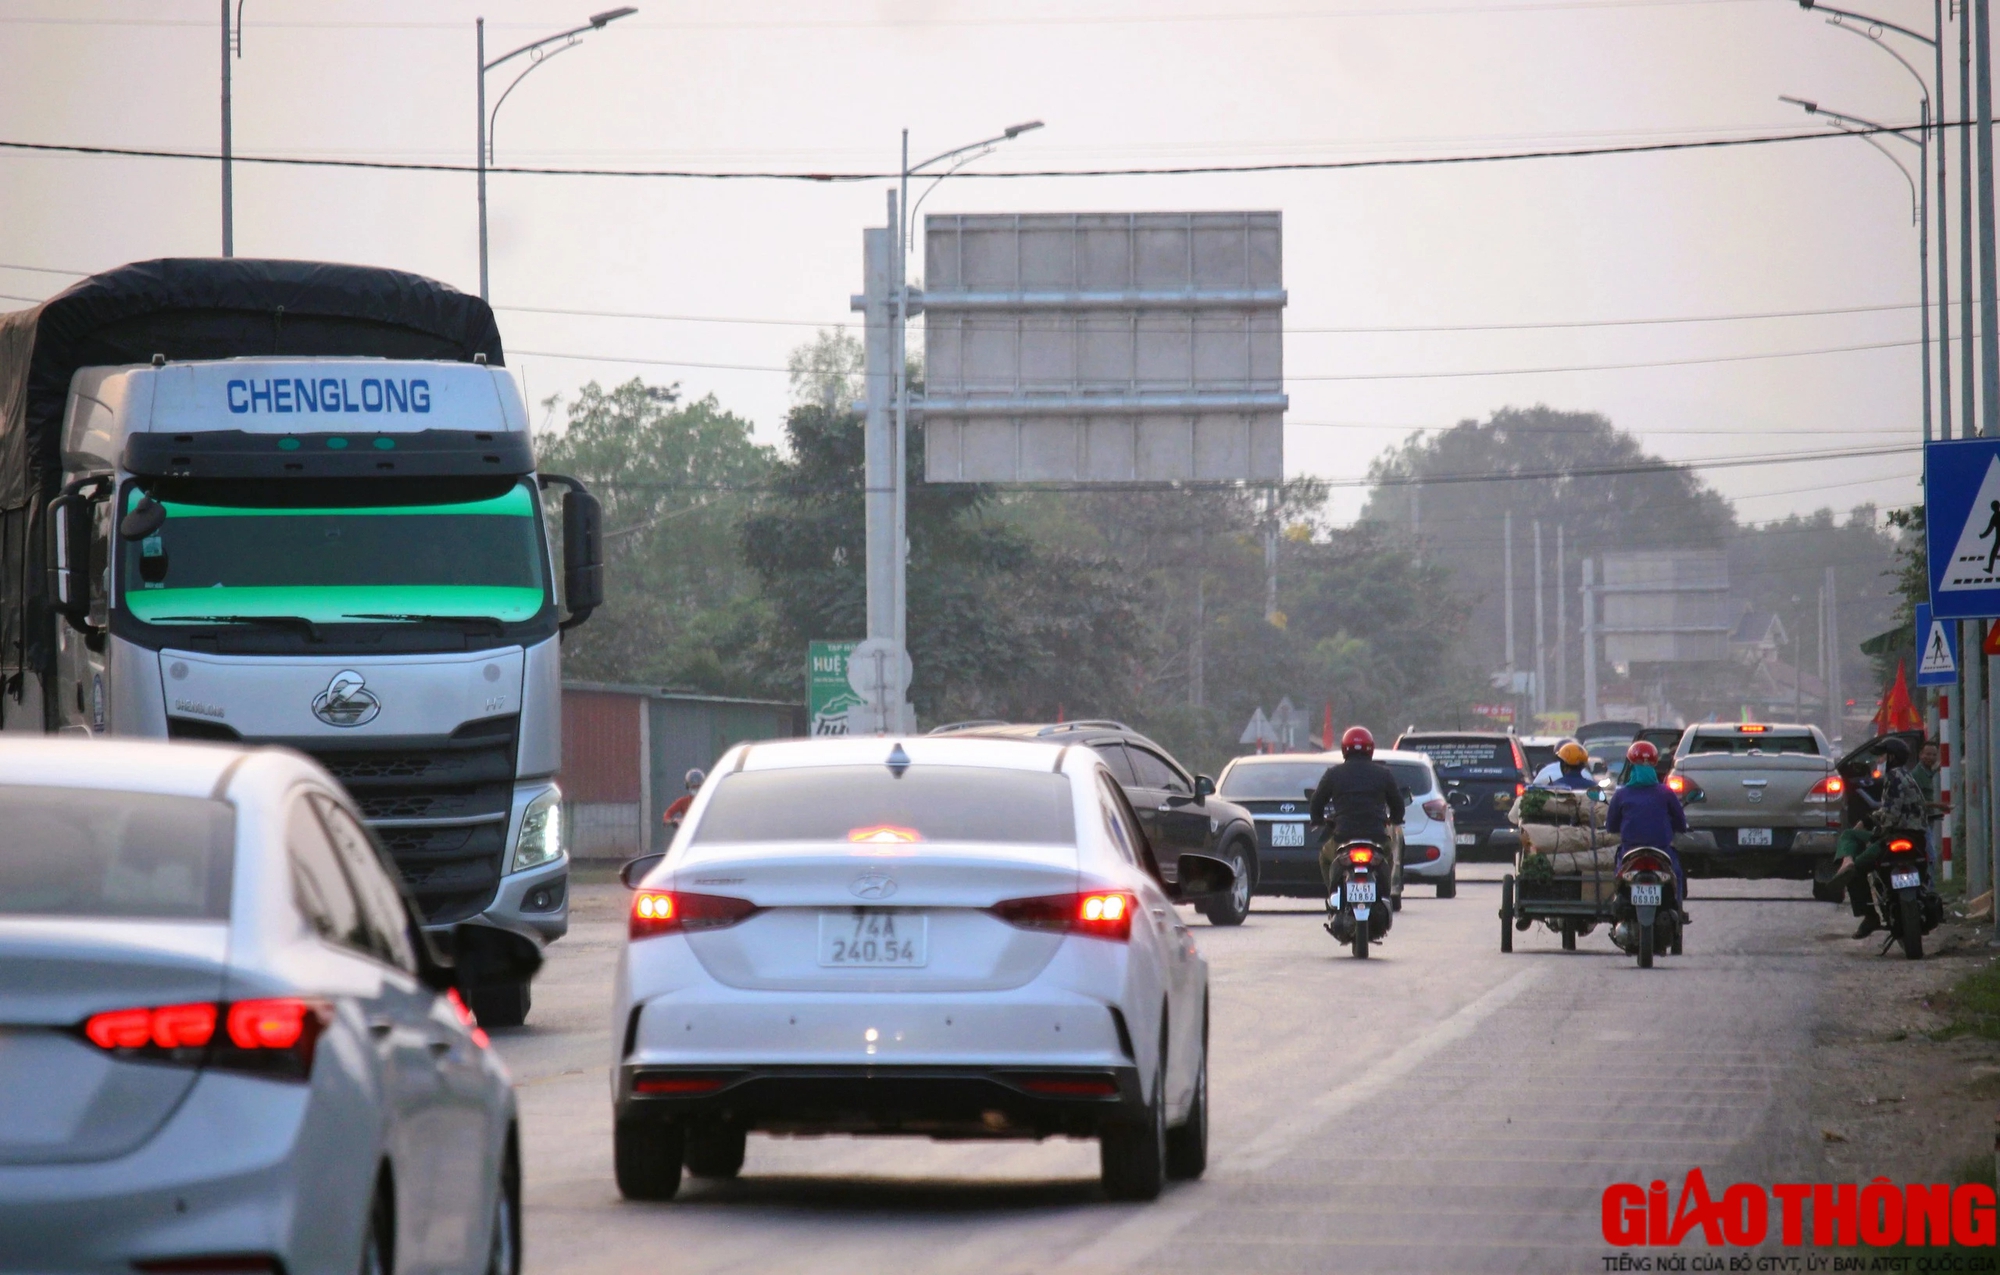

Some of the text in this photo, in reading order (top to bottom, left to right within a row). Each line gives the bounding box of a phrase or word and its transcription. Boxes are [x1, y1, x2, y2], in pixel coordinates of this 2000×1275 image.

[227, 378, 430, 413] CHENGLONG
[813, 655, 841, 676] HUỆ
[852, 913, 896, 937] 74A
[832, 940, 914, 962] 240.54
